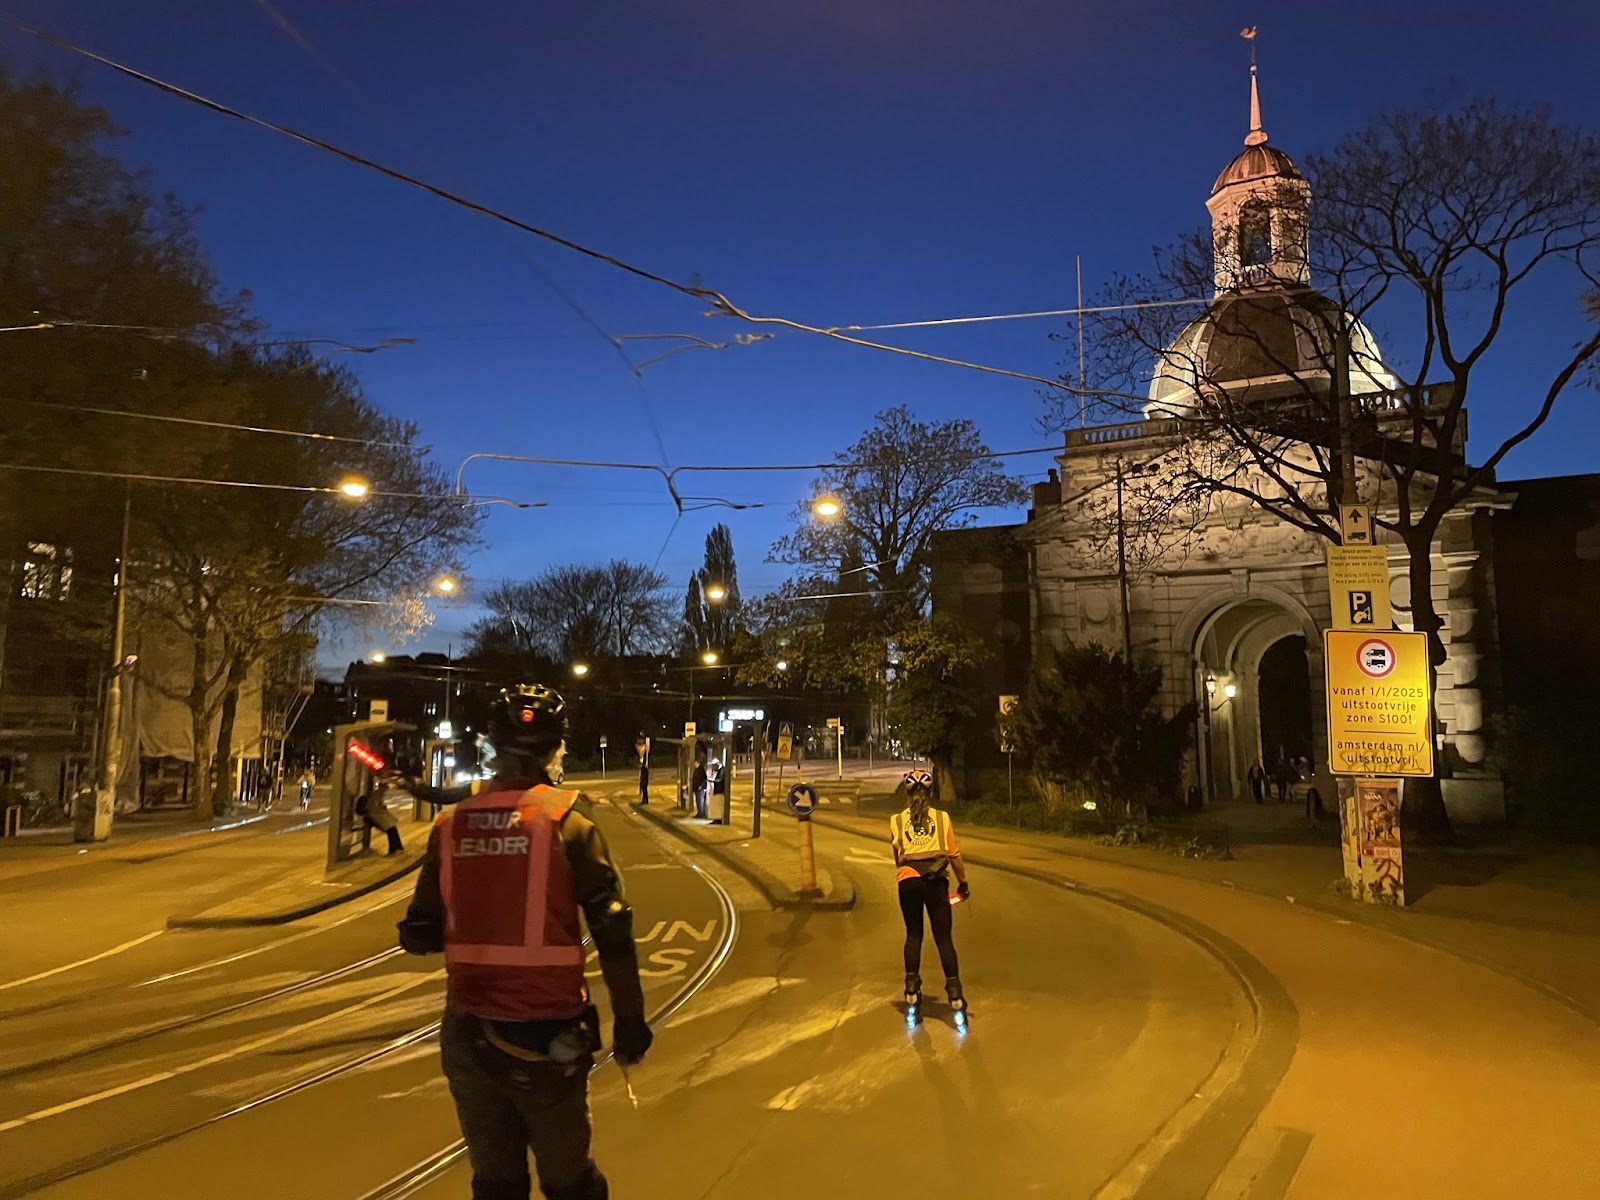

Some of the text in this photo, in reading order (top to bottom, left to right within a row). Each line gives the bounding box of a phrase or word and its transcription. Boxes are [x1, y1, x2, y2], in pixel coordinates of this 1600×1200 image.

[1332, 686, 1424, 698] vanaf 1/1/2025
[1341, 700, 1416, 713] uitstootvrije
[1346, 714, 1412, 724] zone S100!
[1337, 741, 1425, 752] amsterdam.nl/
[1347, 753, 1415, 767] uitstootvrij
[467, 811, 522, 830] TOUR
[453, 836, 529, 857] LEADER
